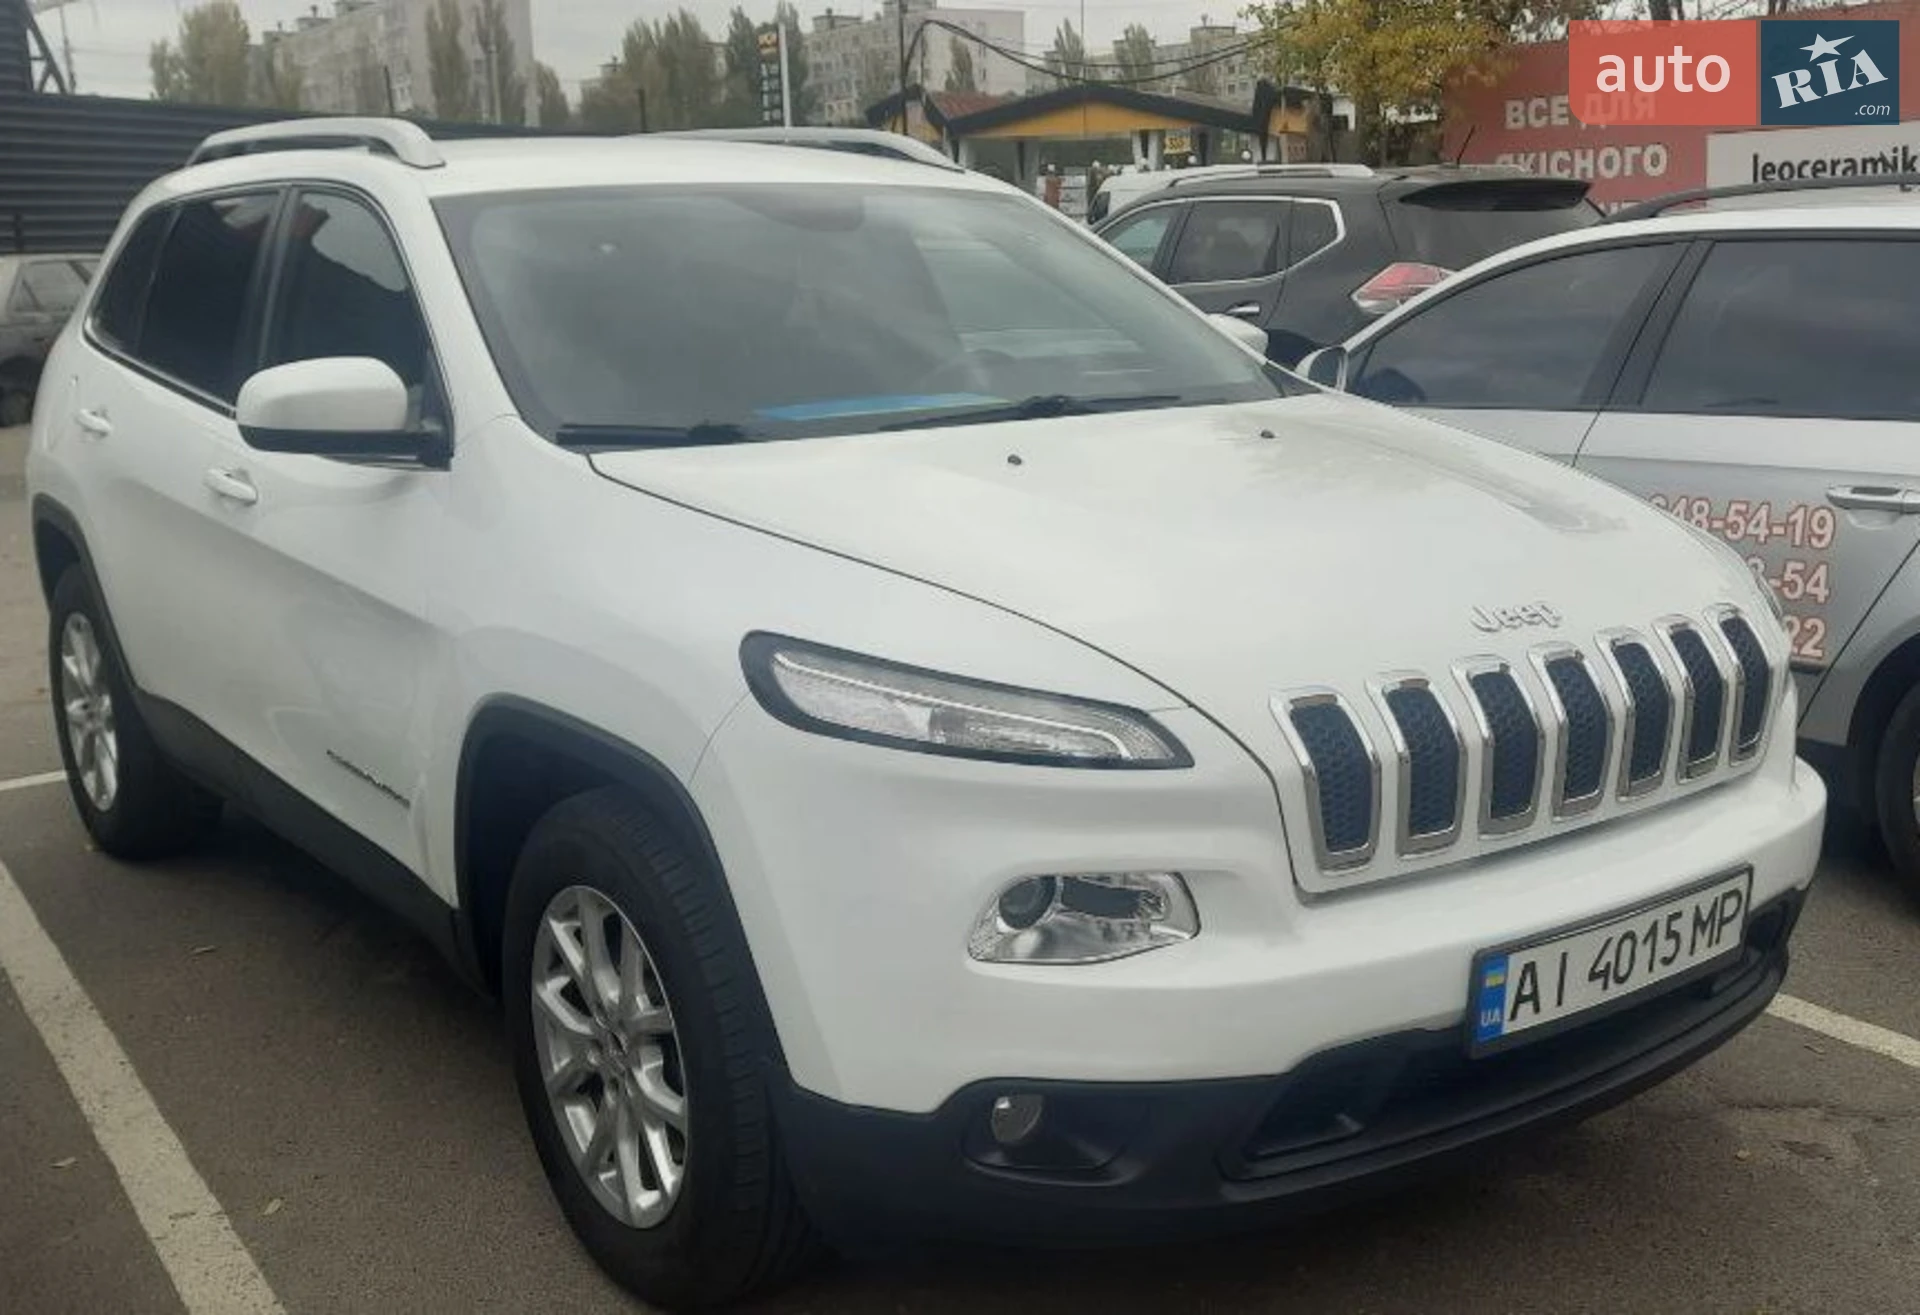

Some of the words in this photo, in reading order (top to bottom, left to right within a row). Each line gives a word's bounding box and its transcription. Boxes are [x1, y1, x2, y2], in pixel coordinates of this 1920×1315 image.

[1505, 95, 1570, 130] ВСЕ
[1470, 602, 1562, 633] Jeep
[1587, 910, 1684, 991] 4015
[1689, 888, 1744, 957] MP
